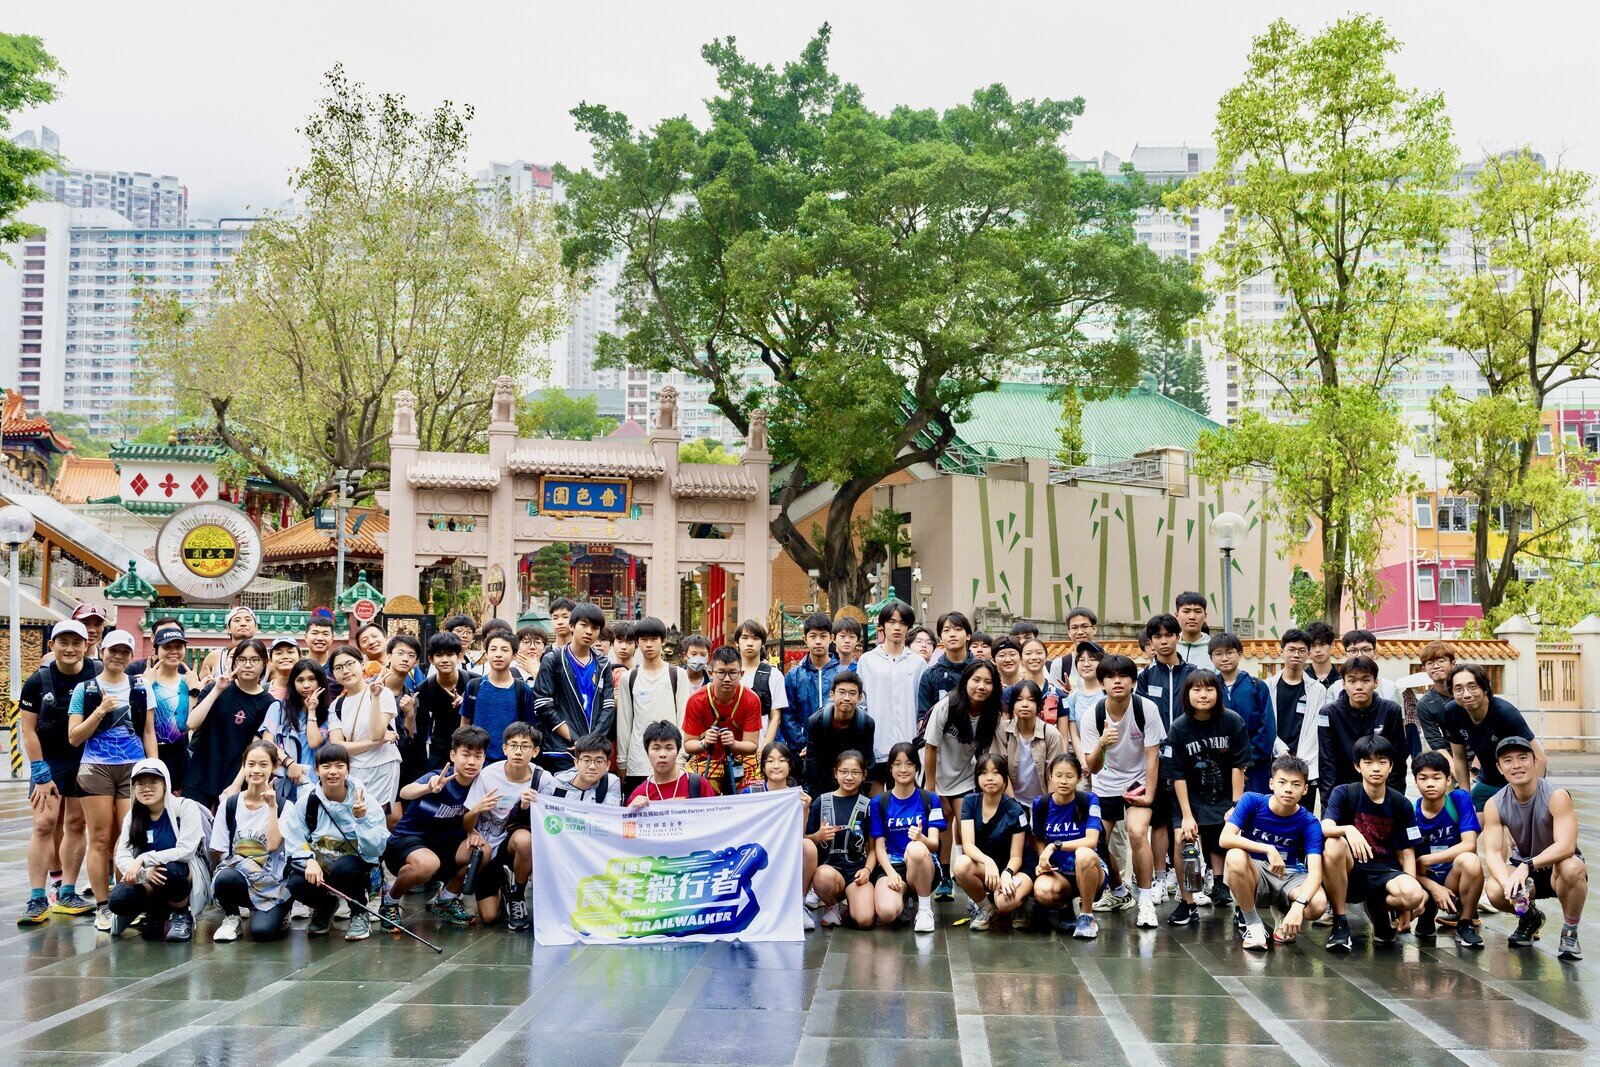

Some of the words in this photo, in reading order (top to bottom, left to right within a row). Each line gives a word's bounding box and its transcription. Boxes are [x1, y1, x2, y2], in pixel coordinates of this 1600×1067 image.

[163, 631, 183, 639] HOKA
[565, 824, 586, 832] OXFAM
[621, 908, 656, 918] OXFAM
[632, 911, 732, 932] TRAILWALKER
